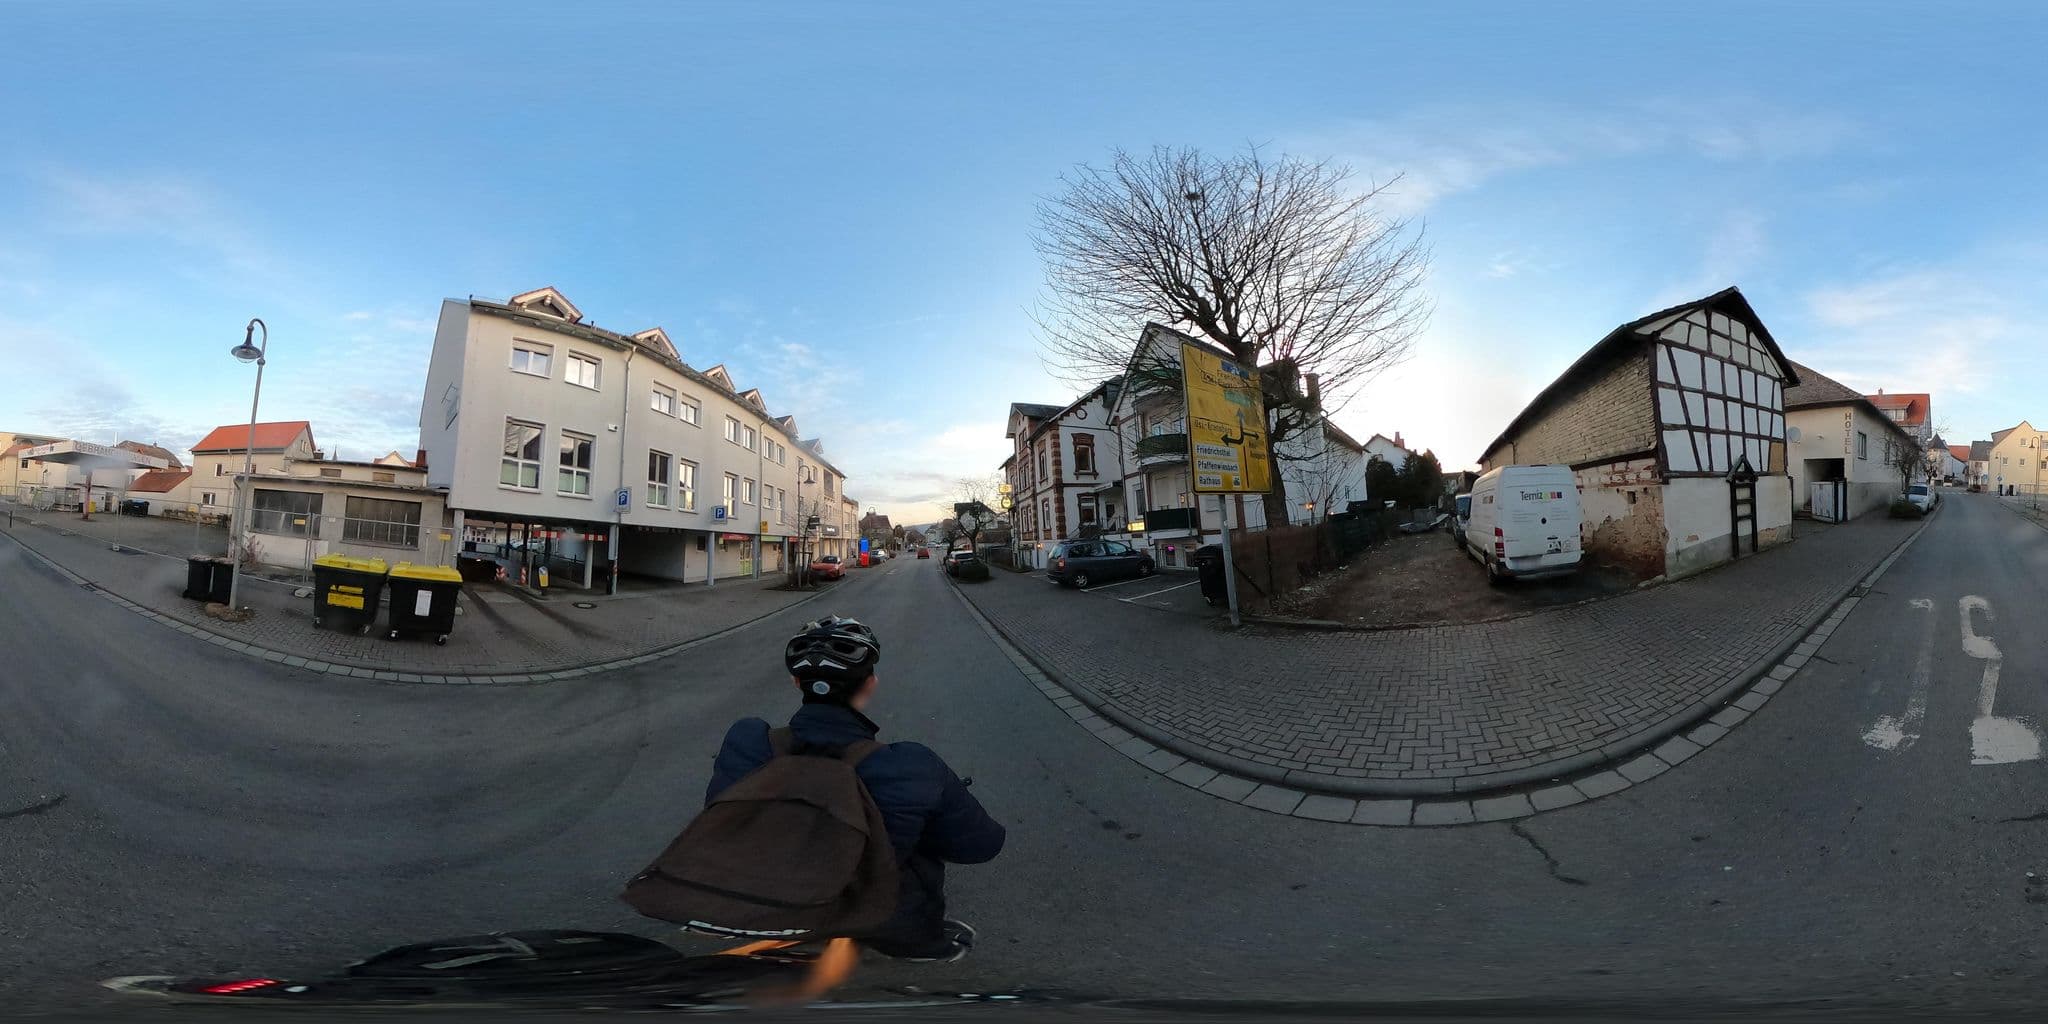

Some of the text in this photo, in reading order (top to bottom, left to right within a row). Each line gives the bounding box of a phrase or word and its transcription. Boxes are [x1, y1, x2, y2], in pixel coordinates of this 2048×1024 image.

[1844, 412, 1852, 455] HOTEL
[1199, 475, 1222, 486] Rathaus
[1520, 488, 1543, 501] Temiz
